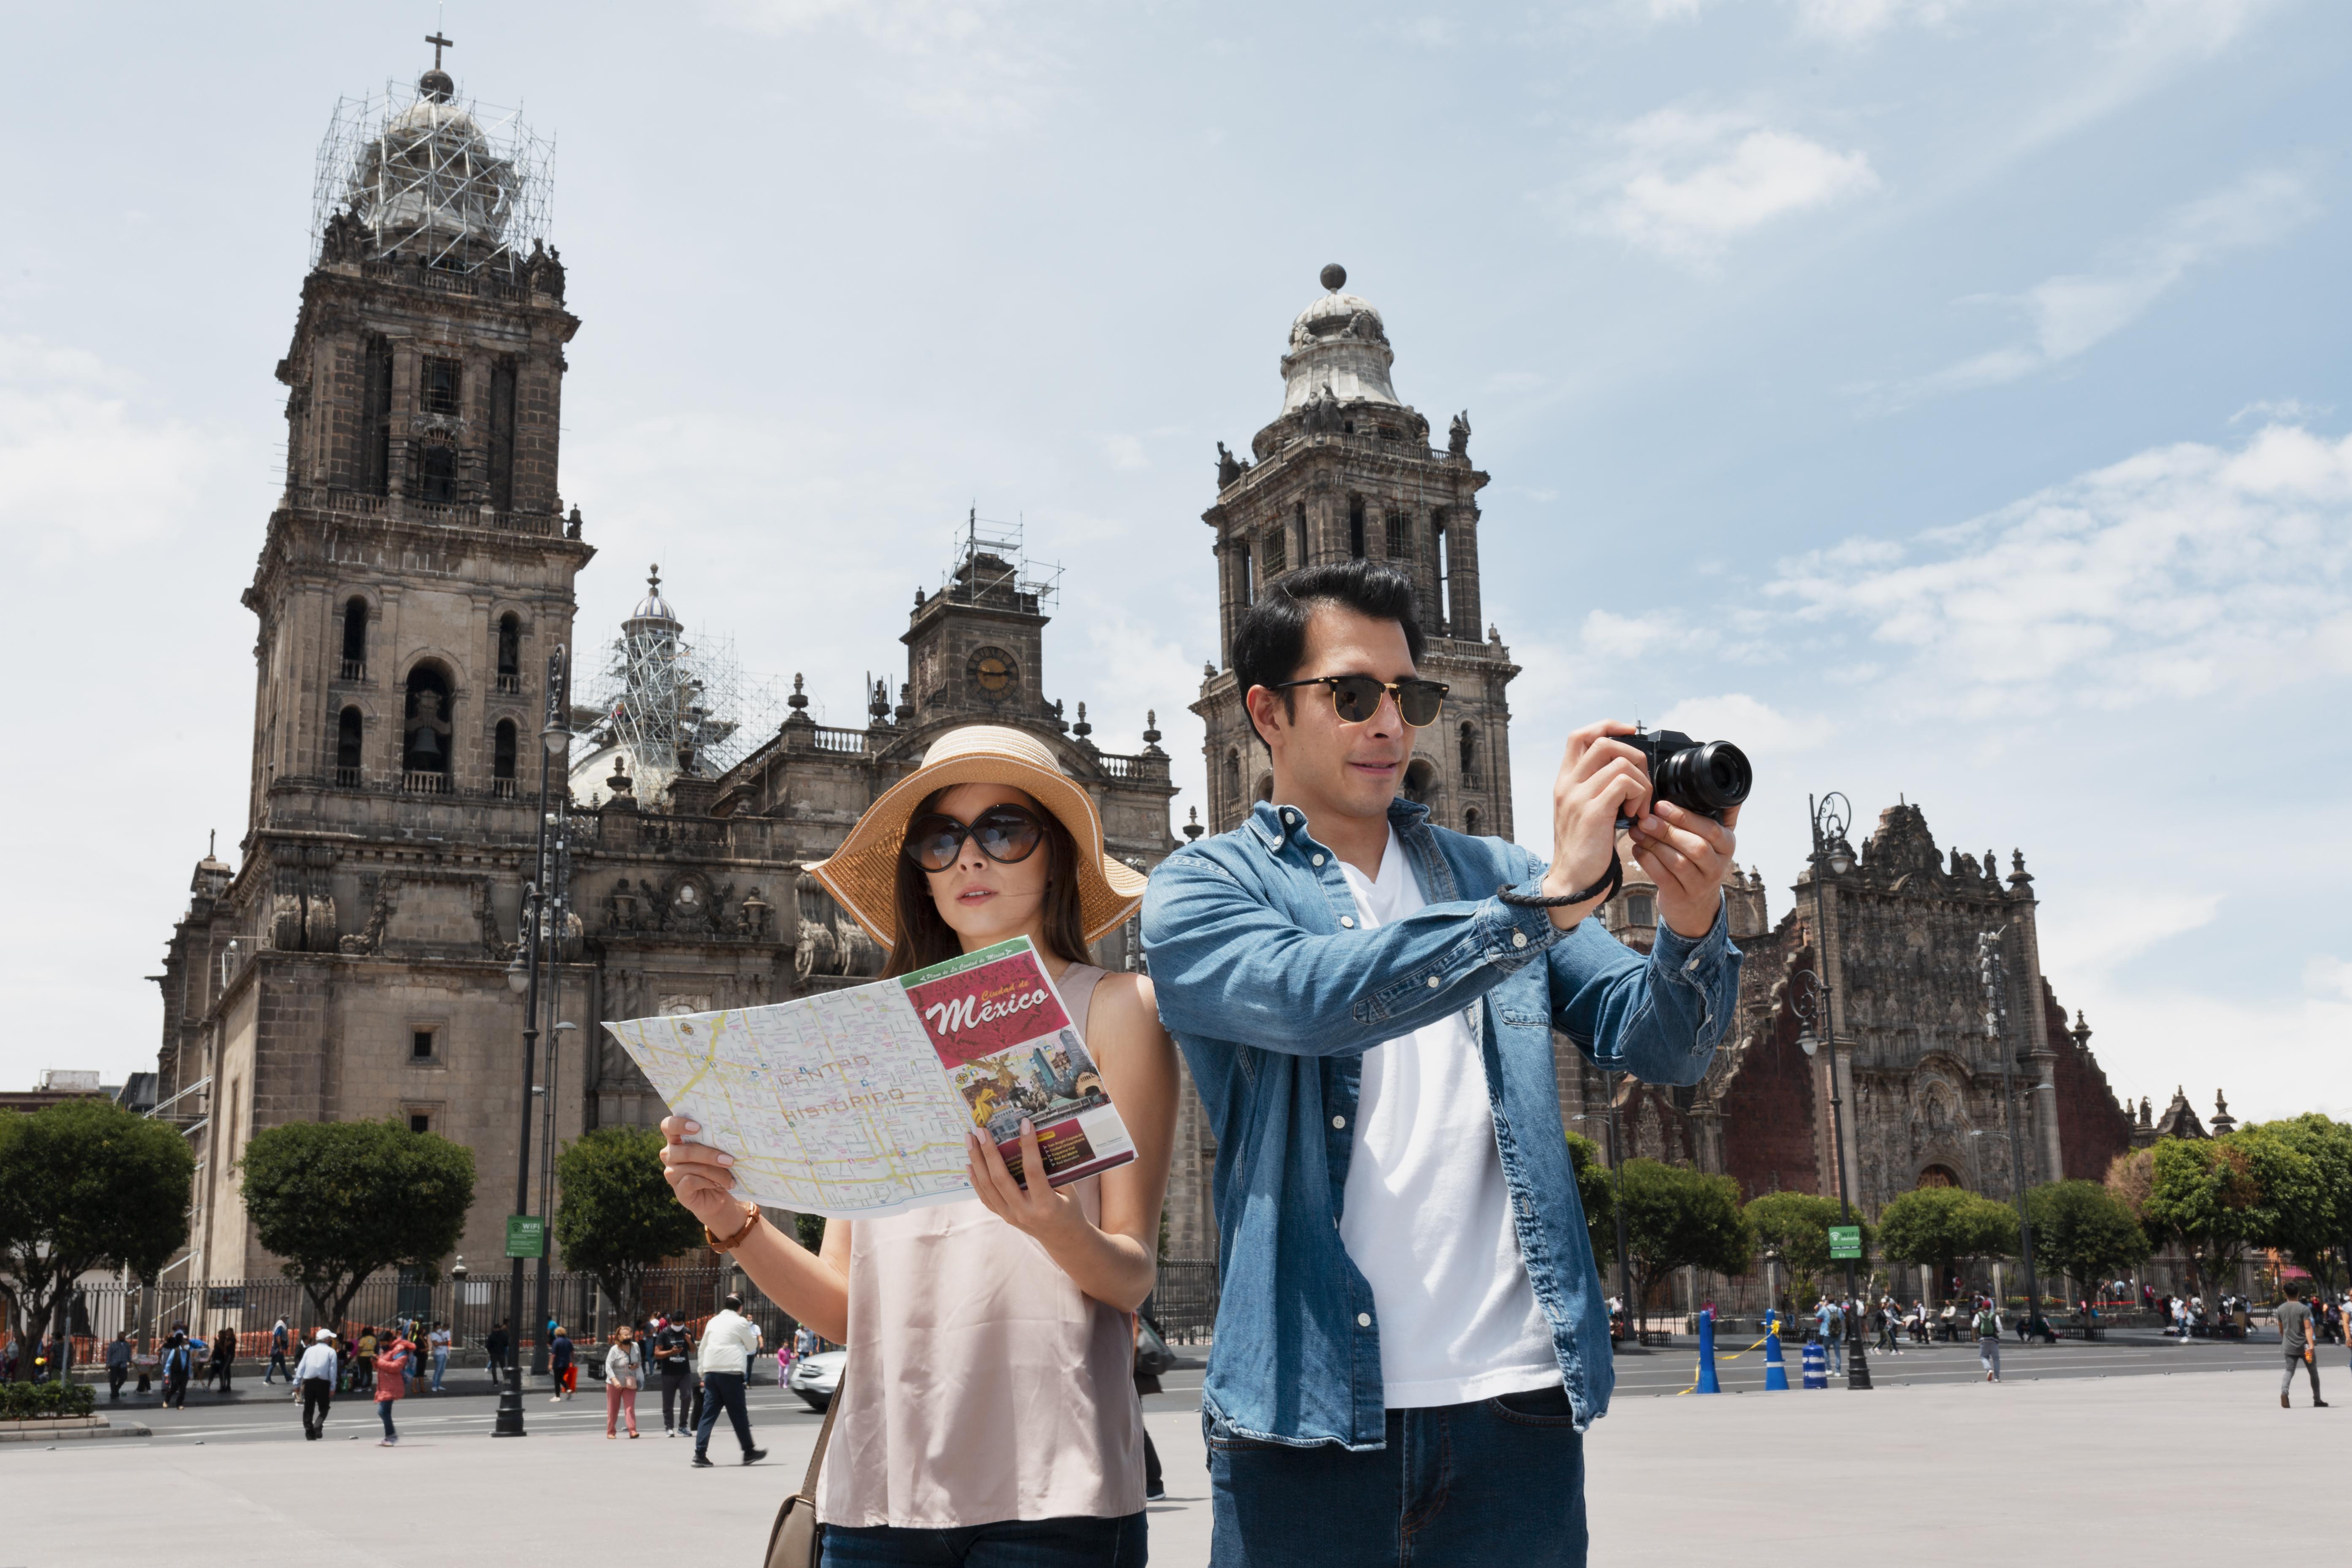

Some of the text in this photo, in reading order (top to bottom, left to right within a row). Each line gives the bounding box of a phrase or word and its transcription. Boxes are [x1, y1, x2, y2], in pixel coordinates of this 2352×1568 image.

[959, 960, 978, 970] Ciudad
[981, 980, 1030, 1001] Ciudad de
[925, 989, 1049, 1036] México
